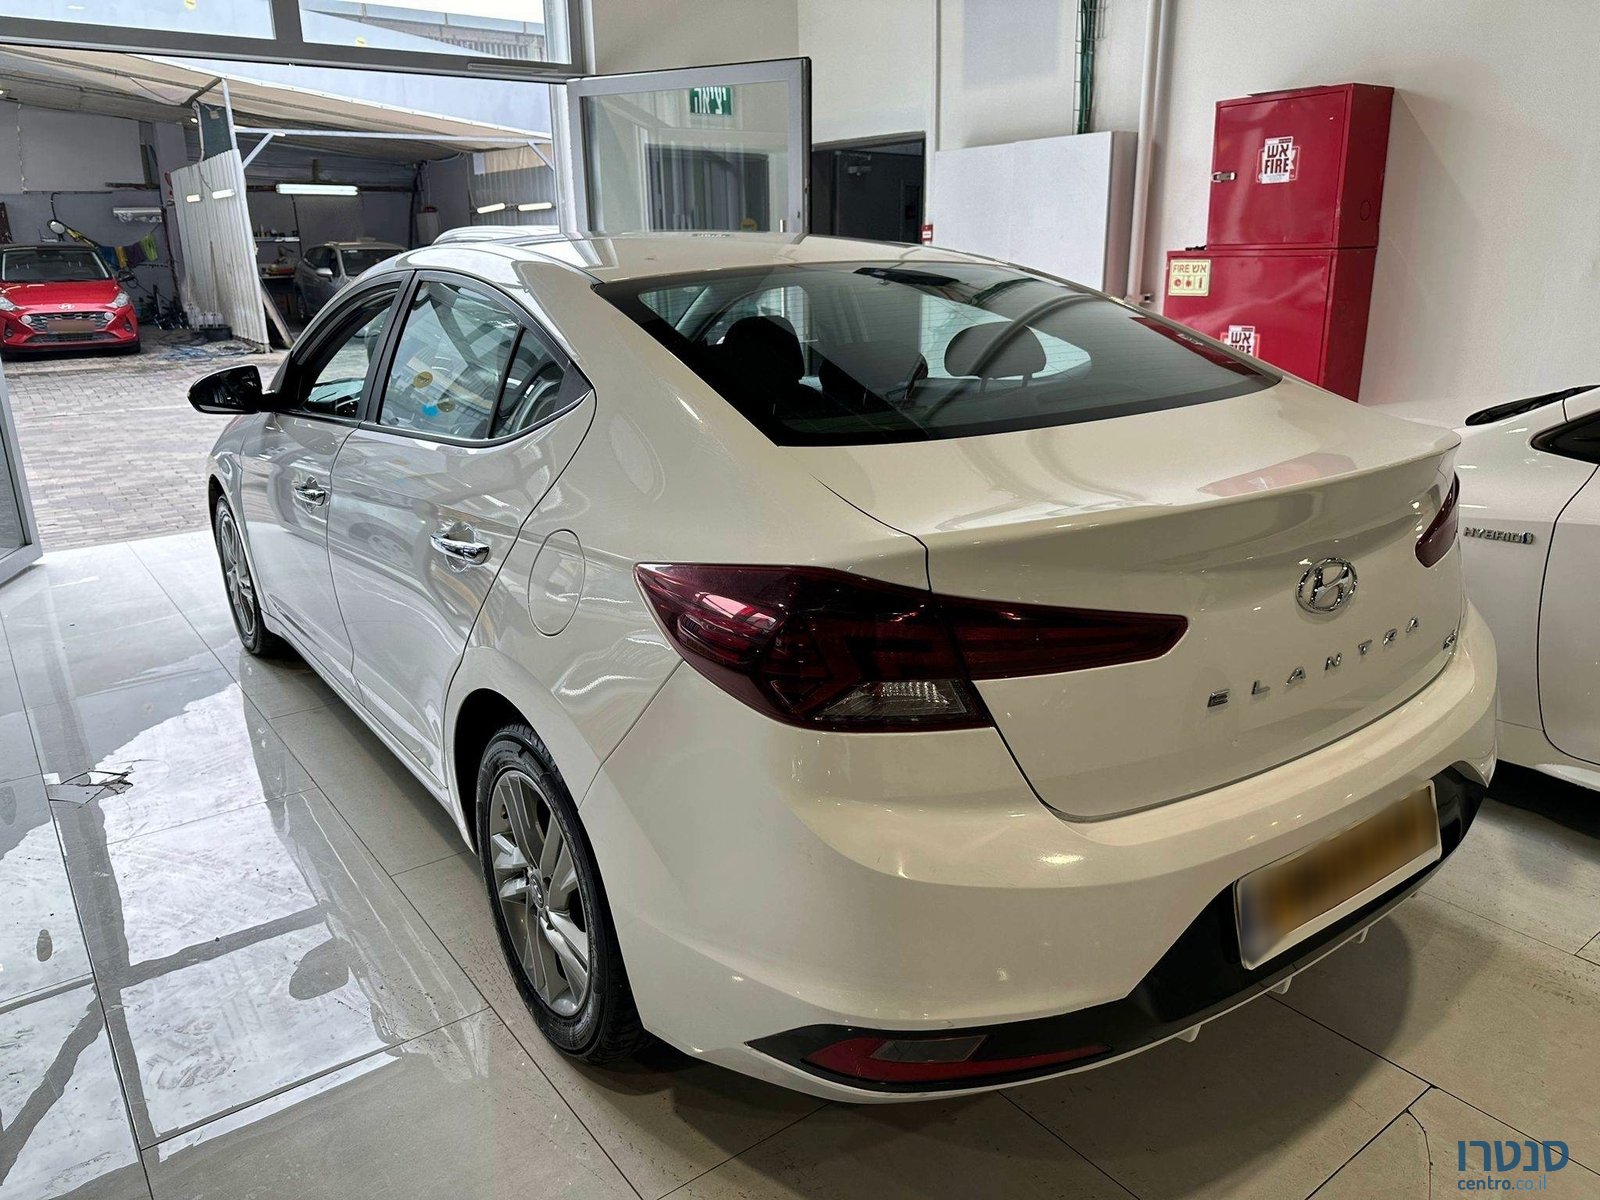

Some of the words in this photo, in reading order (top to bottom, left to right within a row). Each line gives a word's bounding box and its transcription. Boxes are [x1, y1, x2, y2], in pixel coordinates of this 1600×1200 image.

[694, 87, 727, 114] יציאה
[1267, 144, 1289, 158] אש
[1264, 158, 1289, 174] FIRE
[1173, 264, 1190, 273] FIRE
[1192, 264, 1207, 273] אש
[1231, 332, 1251, 344] אש
[1207, 616, 1419, 707] ELANTRA
